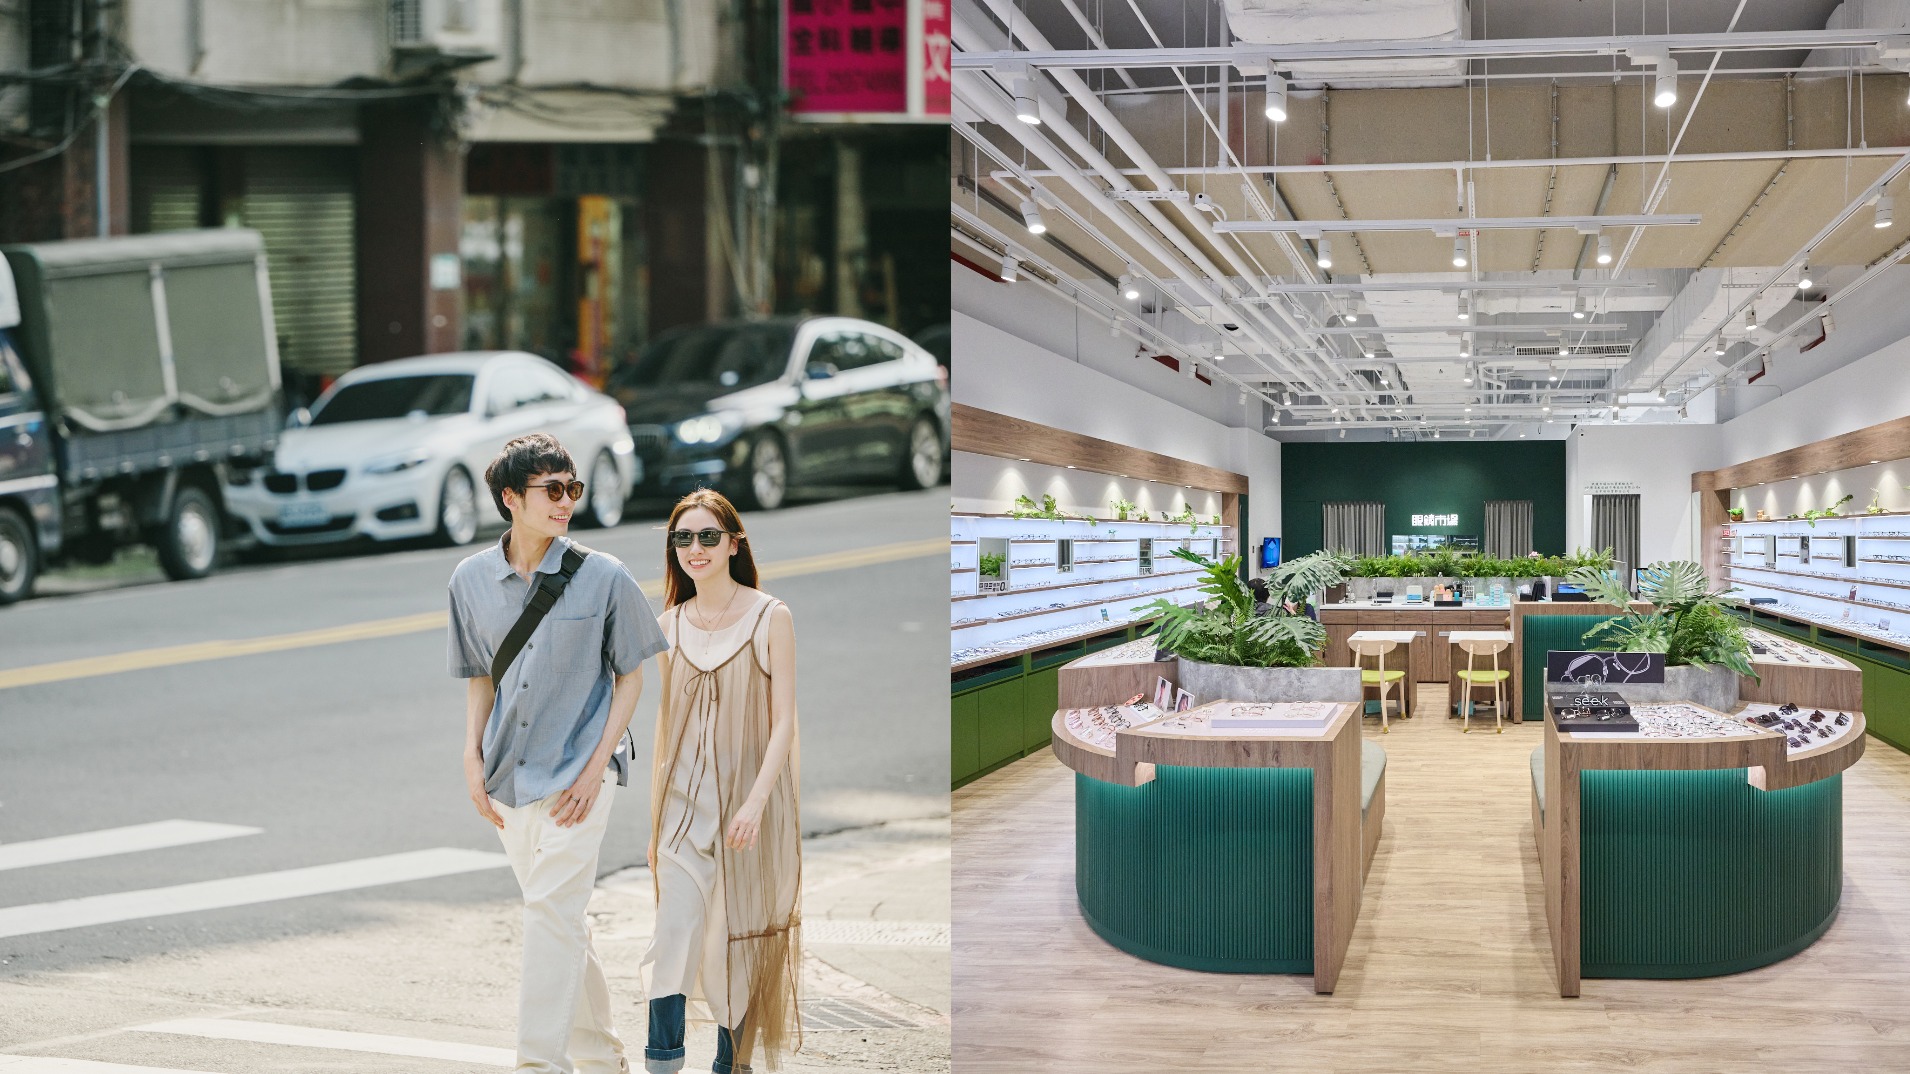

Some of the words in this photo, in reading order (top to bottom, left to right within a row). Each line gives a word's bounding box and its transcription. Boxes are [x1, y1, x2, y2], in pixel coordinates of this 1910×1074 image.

[1411, 514, 1459, 527] 眼鏡市場
[1574, 695, 1609, 706] seek
